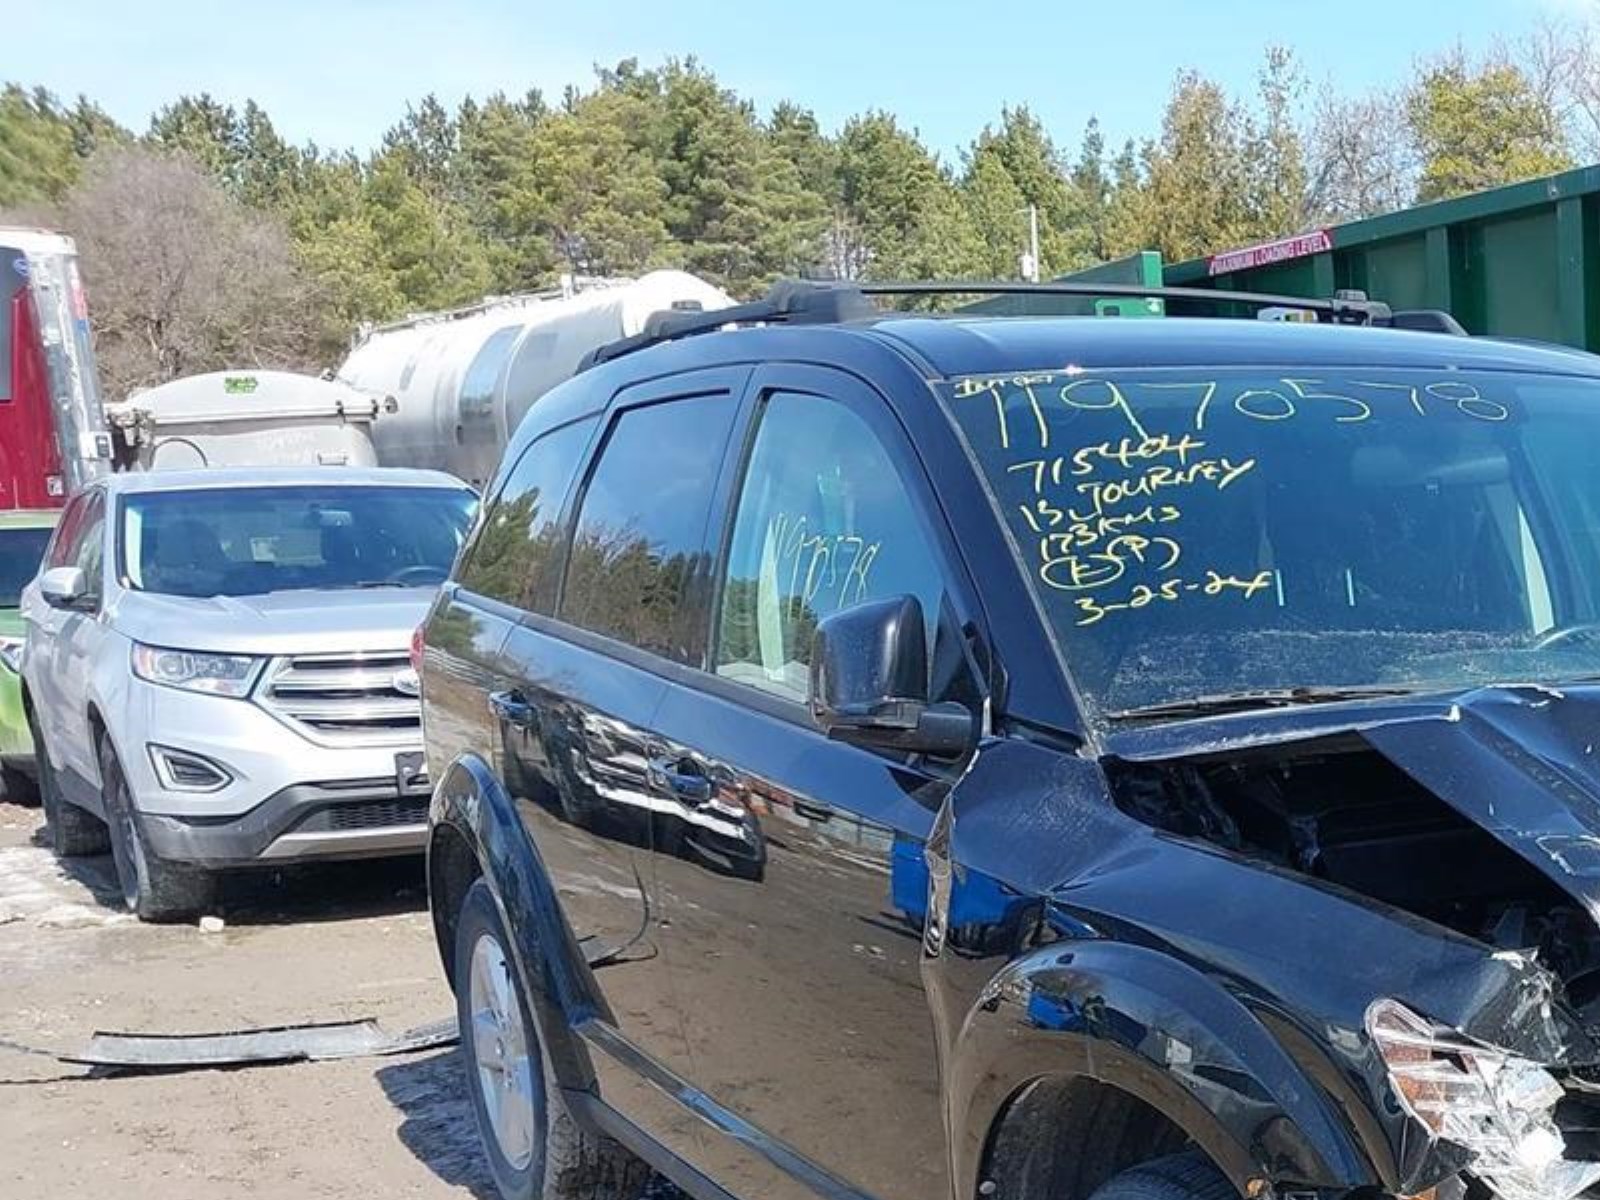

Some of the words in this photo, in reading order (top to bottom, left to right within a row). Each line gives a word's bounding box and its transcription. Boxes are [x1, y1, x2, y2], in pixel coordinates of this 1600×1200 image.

[987, 378, 1508, 449] 11970578
[1007, 434, 1206, 494] 715404
[1068, 458, 1256, 520] JOURNEY
[1074, 571, 1273, 626] 3-25-24
